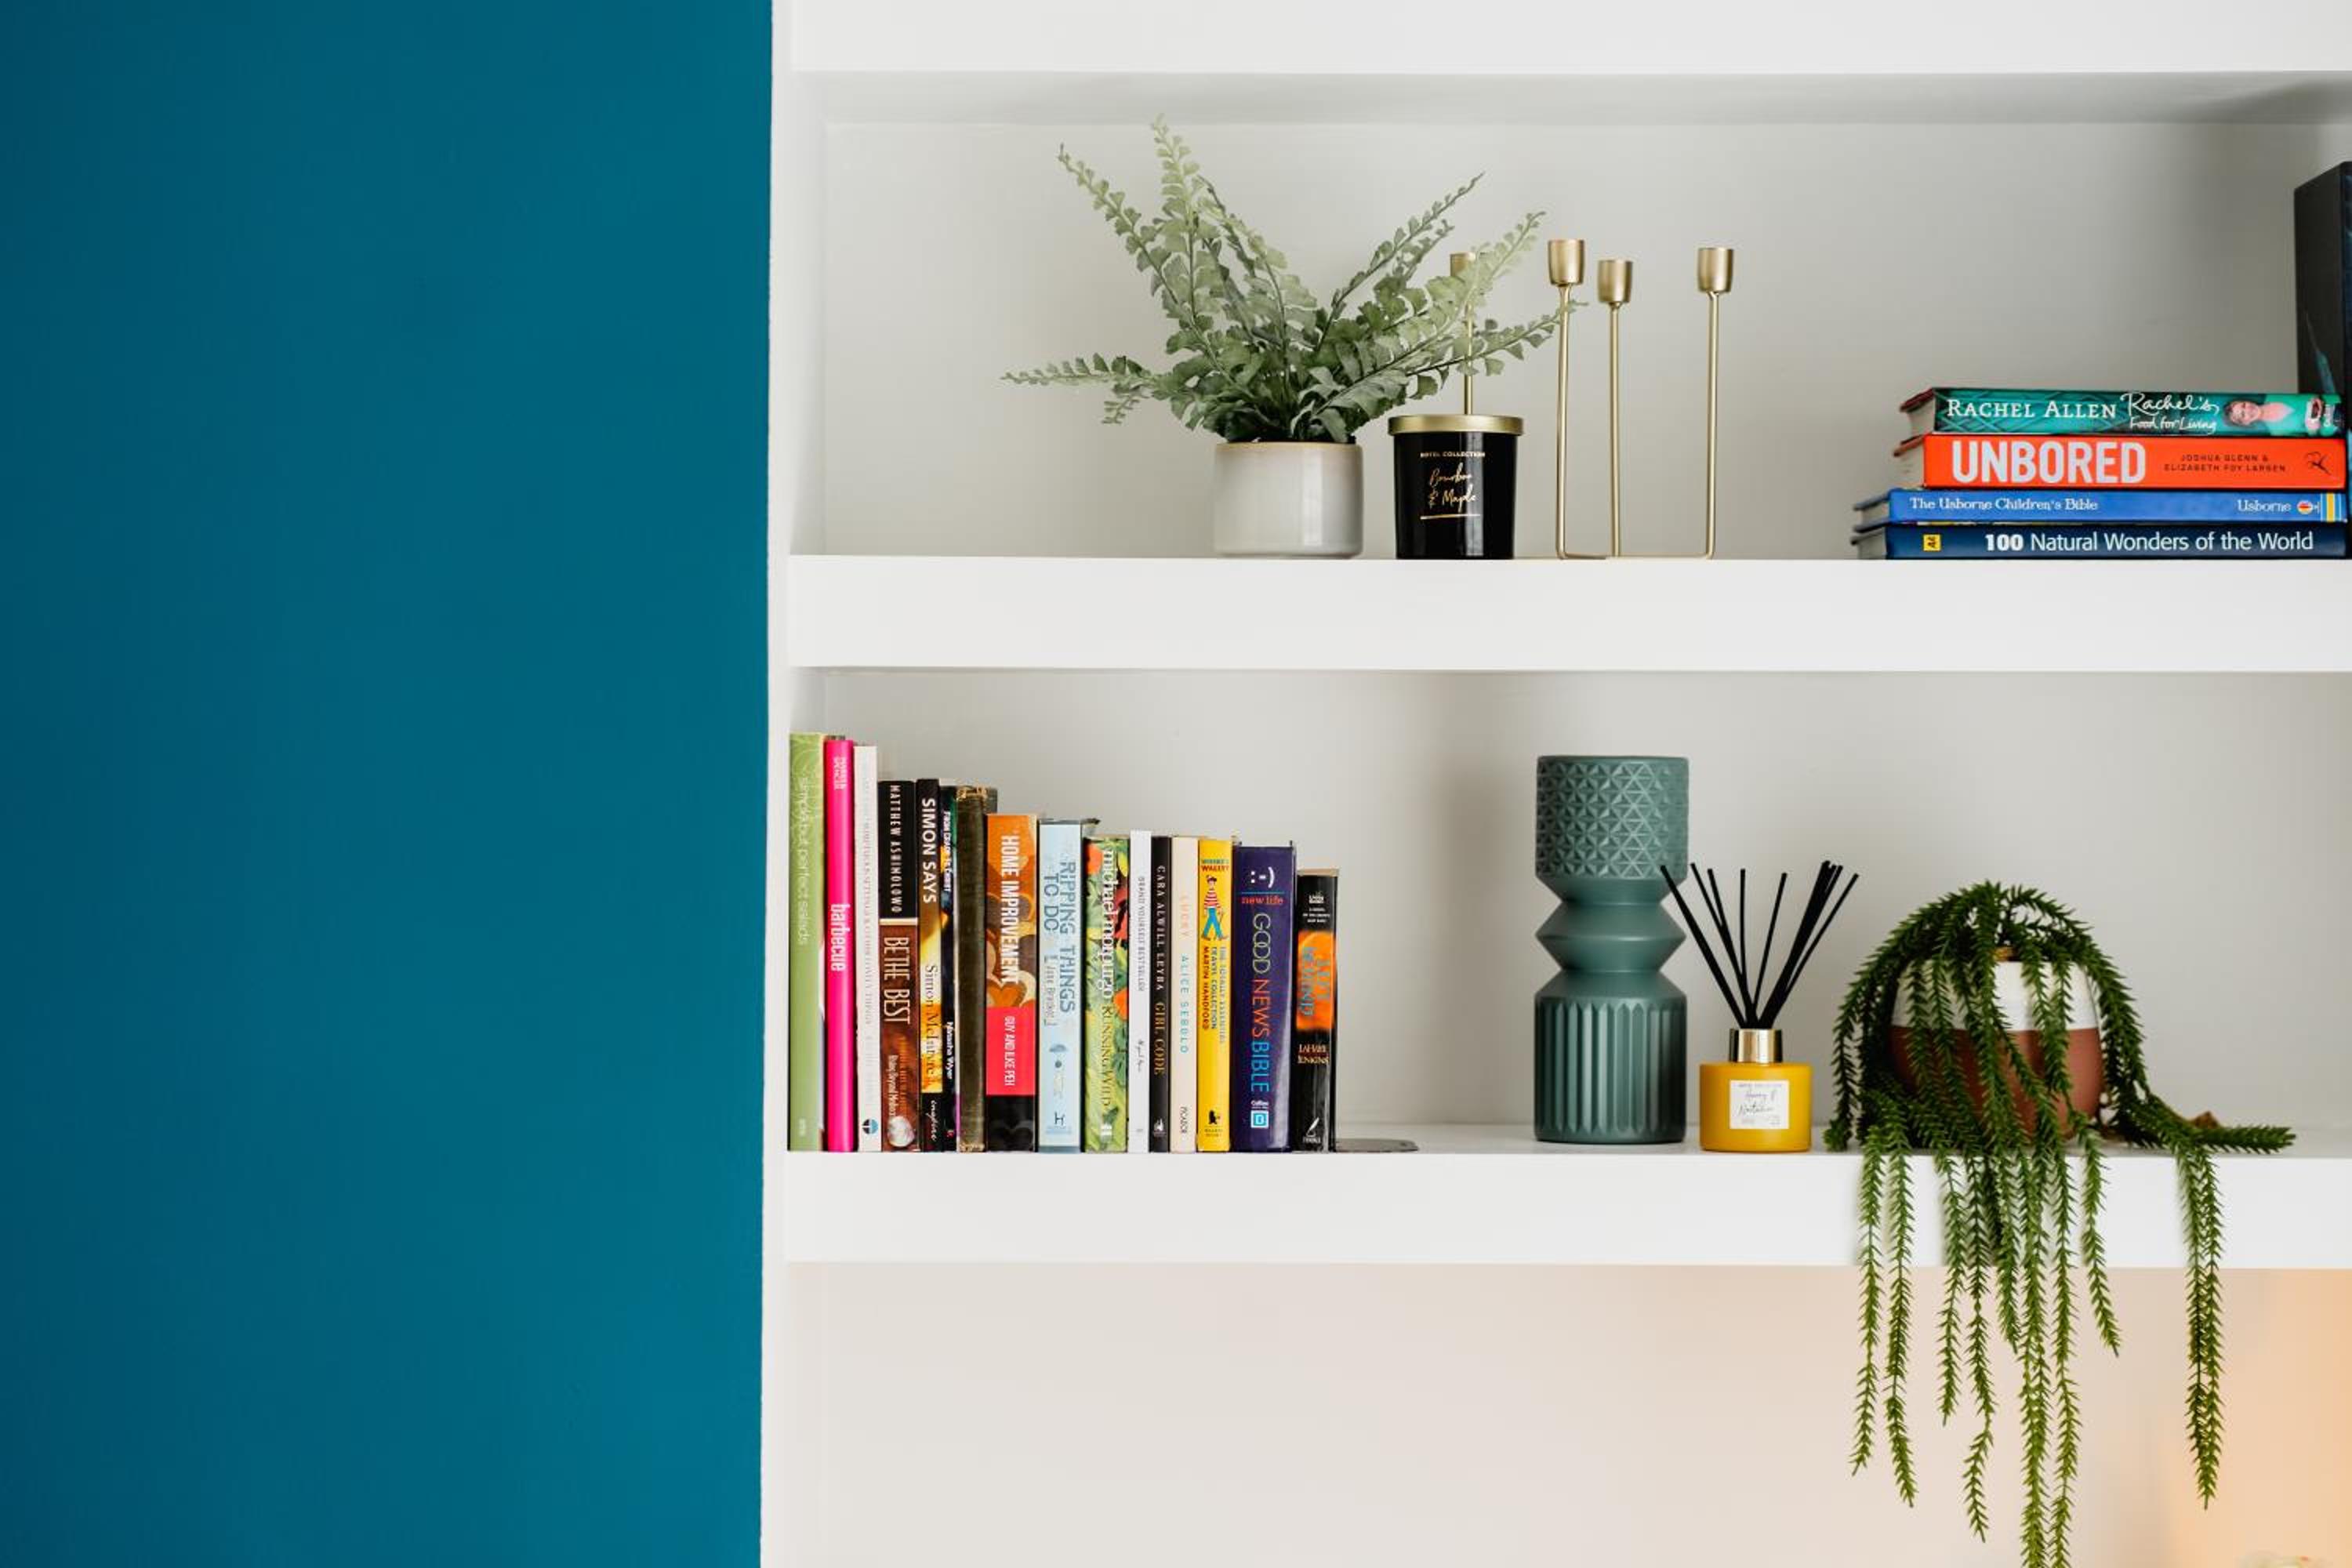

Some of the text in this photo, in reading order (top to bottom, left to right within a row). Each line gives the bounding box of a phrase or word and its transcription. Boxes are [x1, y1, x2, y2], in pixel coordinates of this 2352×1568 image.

[1947, 399, 2117, 419] RACHEL ALLEN
[2120, 393, 2220, 417] Rachel's
[2130, 416, 2217, 435] Food for Living
[1952, 441, 2147, 484] UNBORED
[2181, 454, 2221, 463] JOSHUA
[2224, 454, 2259, 463] GLENN
[1910, 496, 2100, 510] The Usborne Children's Bible
[2237, 499, 2292, 512] Usborne
[1985, 531, 2314, 551] 100 Natural Wonders of the World
[891, 785, 902, 837] MATTHEW
[922, 797, 937, 904] SIMON SAYS
[1000, 834, 1020, 985] HOME IMPROVEMENT
[1044, 873, 1059, 931] TO DO
[1097, 850, 1119, 999] michael morpurgo
[1156, 865, 1166, 991] CARA ALWILL LEYBA
[830, 903, 851, 971] barbecue
[1059, 862, 1077, 1013] RIPPING THINGS
[1138, 877, 1146, 992] BRAND YOURSELF BESTSELLER
[1252, 913, 1271, 975] GOOD
[884, 989, 909, 1024] BEST
[924, 965, 939, 1007] Simon
[1181, 955, 1190, 1054] ALICE SEBOLD
[1252, 978, 1271, 1038] NEWS
[1004, 1015, 1015, 1033] GUY
[1004, 1033, 1015, 1051] AND
[1154, 1002, 1167, 1076] GIRL CODE
[1101, 1005, 1115, 1108] RUNNING WILD
[1252, 1041, 1271, 1093] BIBLE
[926, 1099, 938, 1142] inspire
